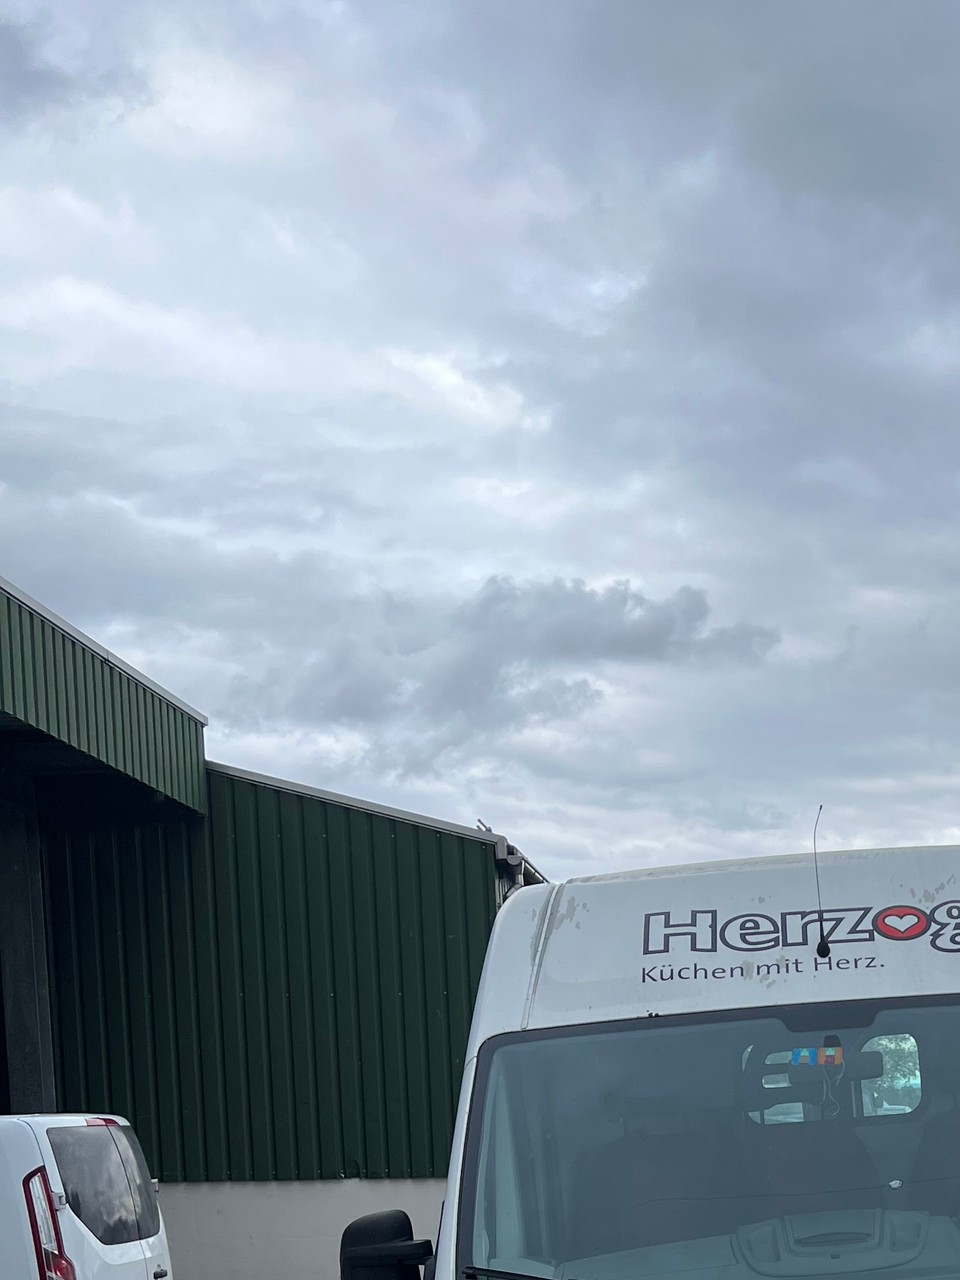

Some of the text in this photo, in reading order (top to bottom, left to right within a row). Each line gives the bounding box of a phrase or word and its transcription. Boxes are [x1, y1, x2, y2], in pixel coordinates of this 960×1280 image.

[641, 955, 886, 983] Küchen mit Herz.
